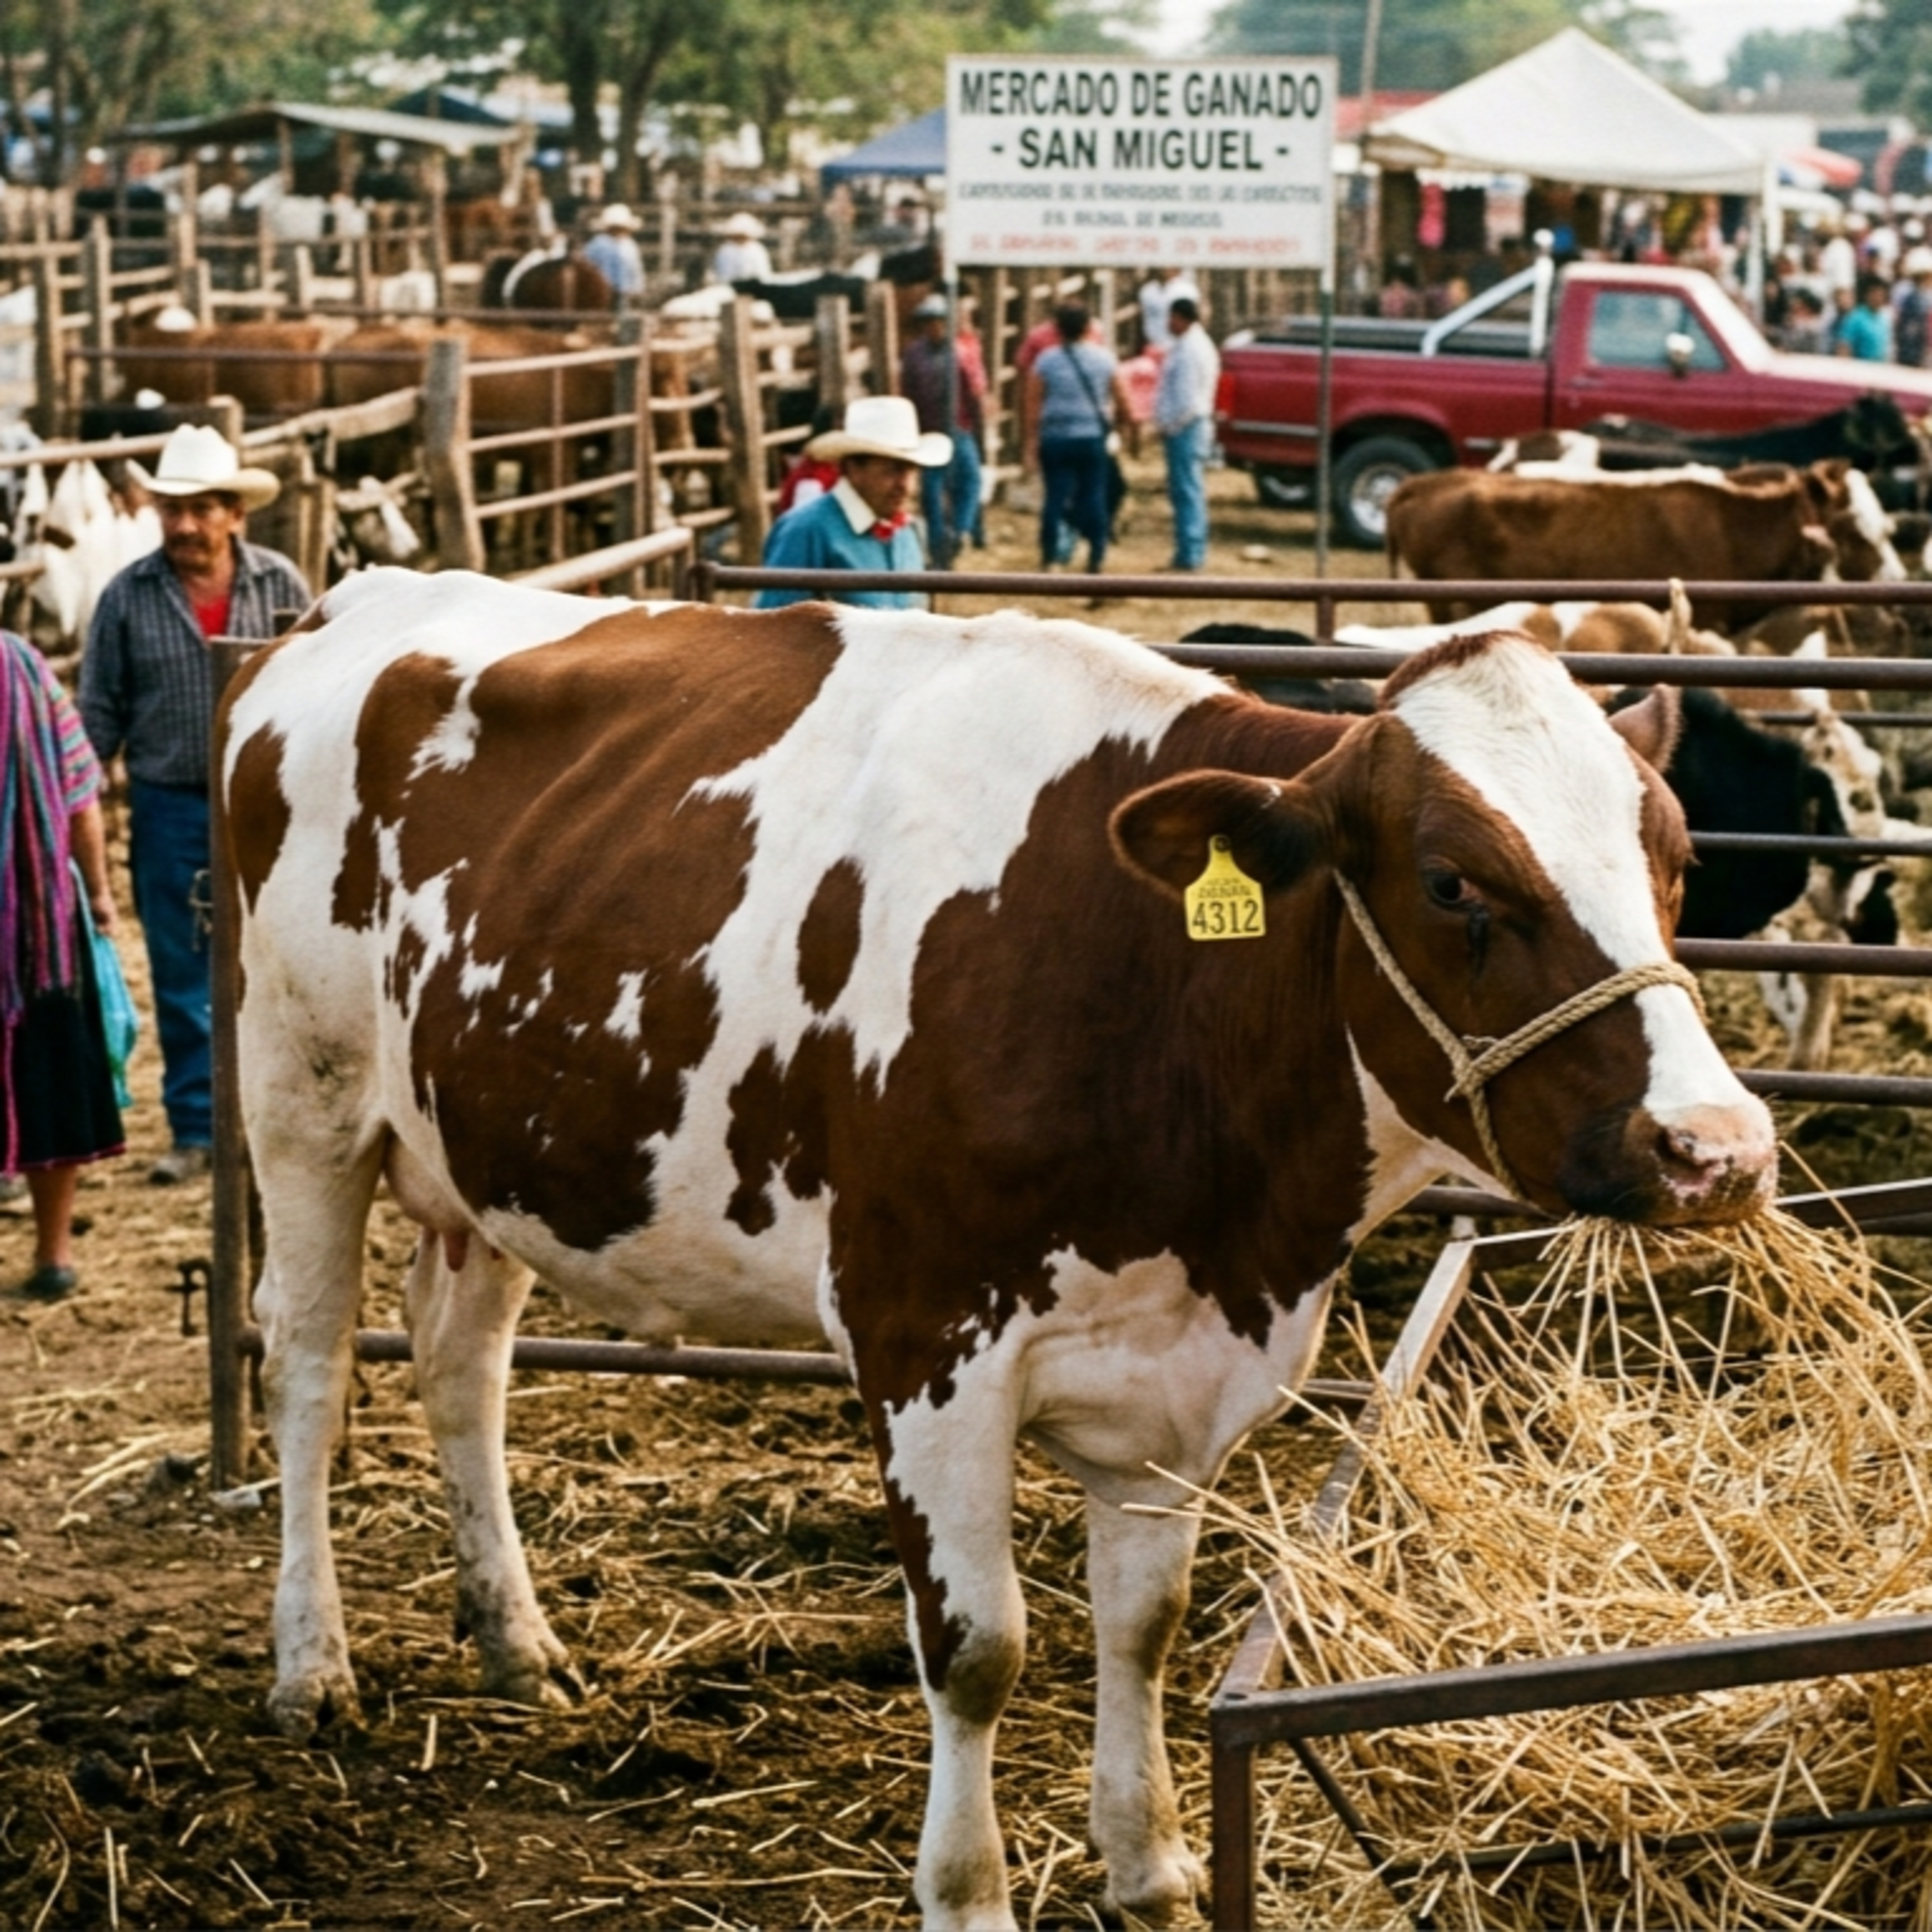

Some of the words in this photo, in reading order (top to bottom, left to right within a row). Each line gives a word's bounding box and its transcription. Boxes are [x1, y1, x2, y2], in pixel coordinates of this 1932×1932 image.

[961, 70, 1117, 117] MERCADO
[1132, 71, 1170, 117] DE
[1184, 72, 1321, 118] GANADO
[1019, 128, 1096, 169] SAN
[1114, 129, 1263, 171] MIGUEL
[1193, 899, 1260, 934] 4312
